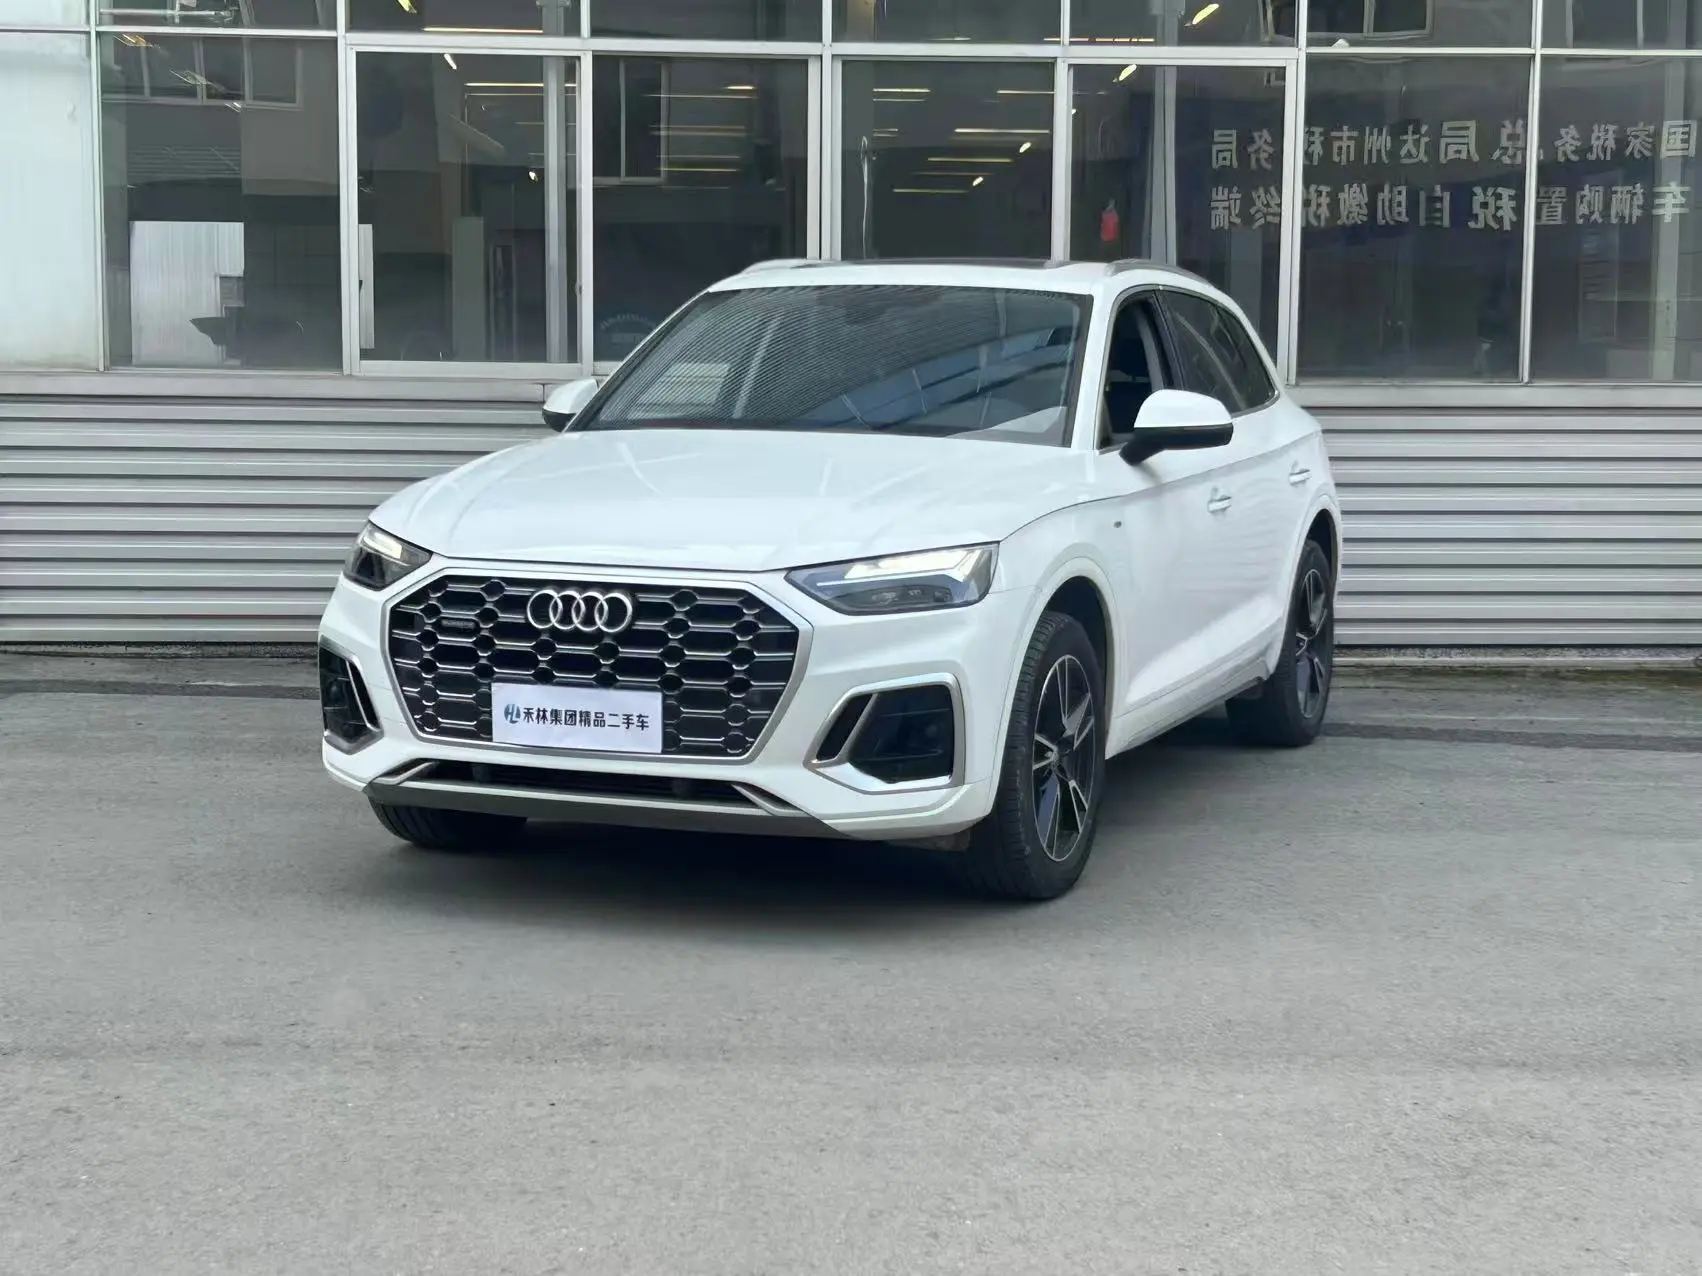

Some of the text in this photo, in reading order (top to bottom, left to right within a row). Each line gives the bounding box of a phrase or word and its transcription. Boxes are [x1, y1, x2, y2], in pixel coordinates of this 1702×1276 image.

[523, 707, 649, 731] 禾林集团精品二手车
